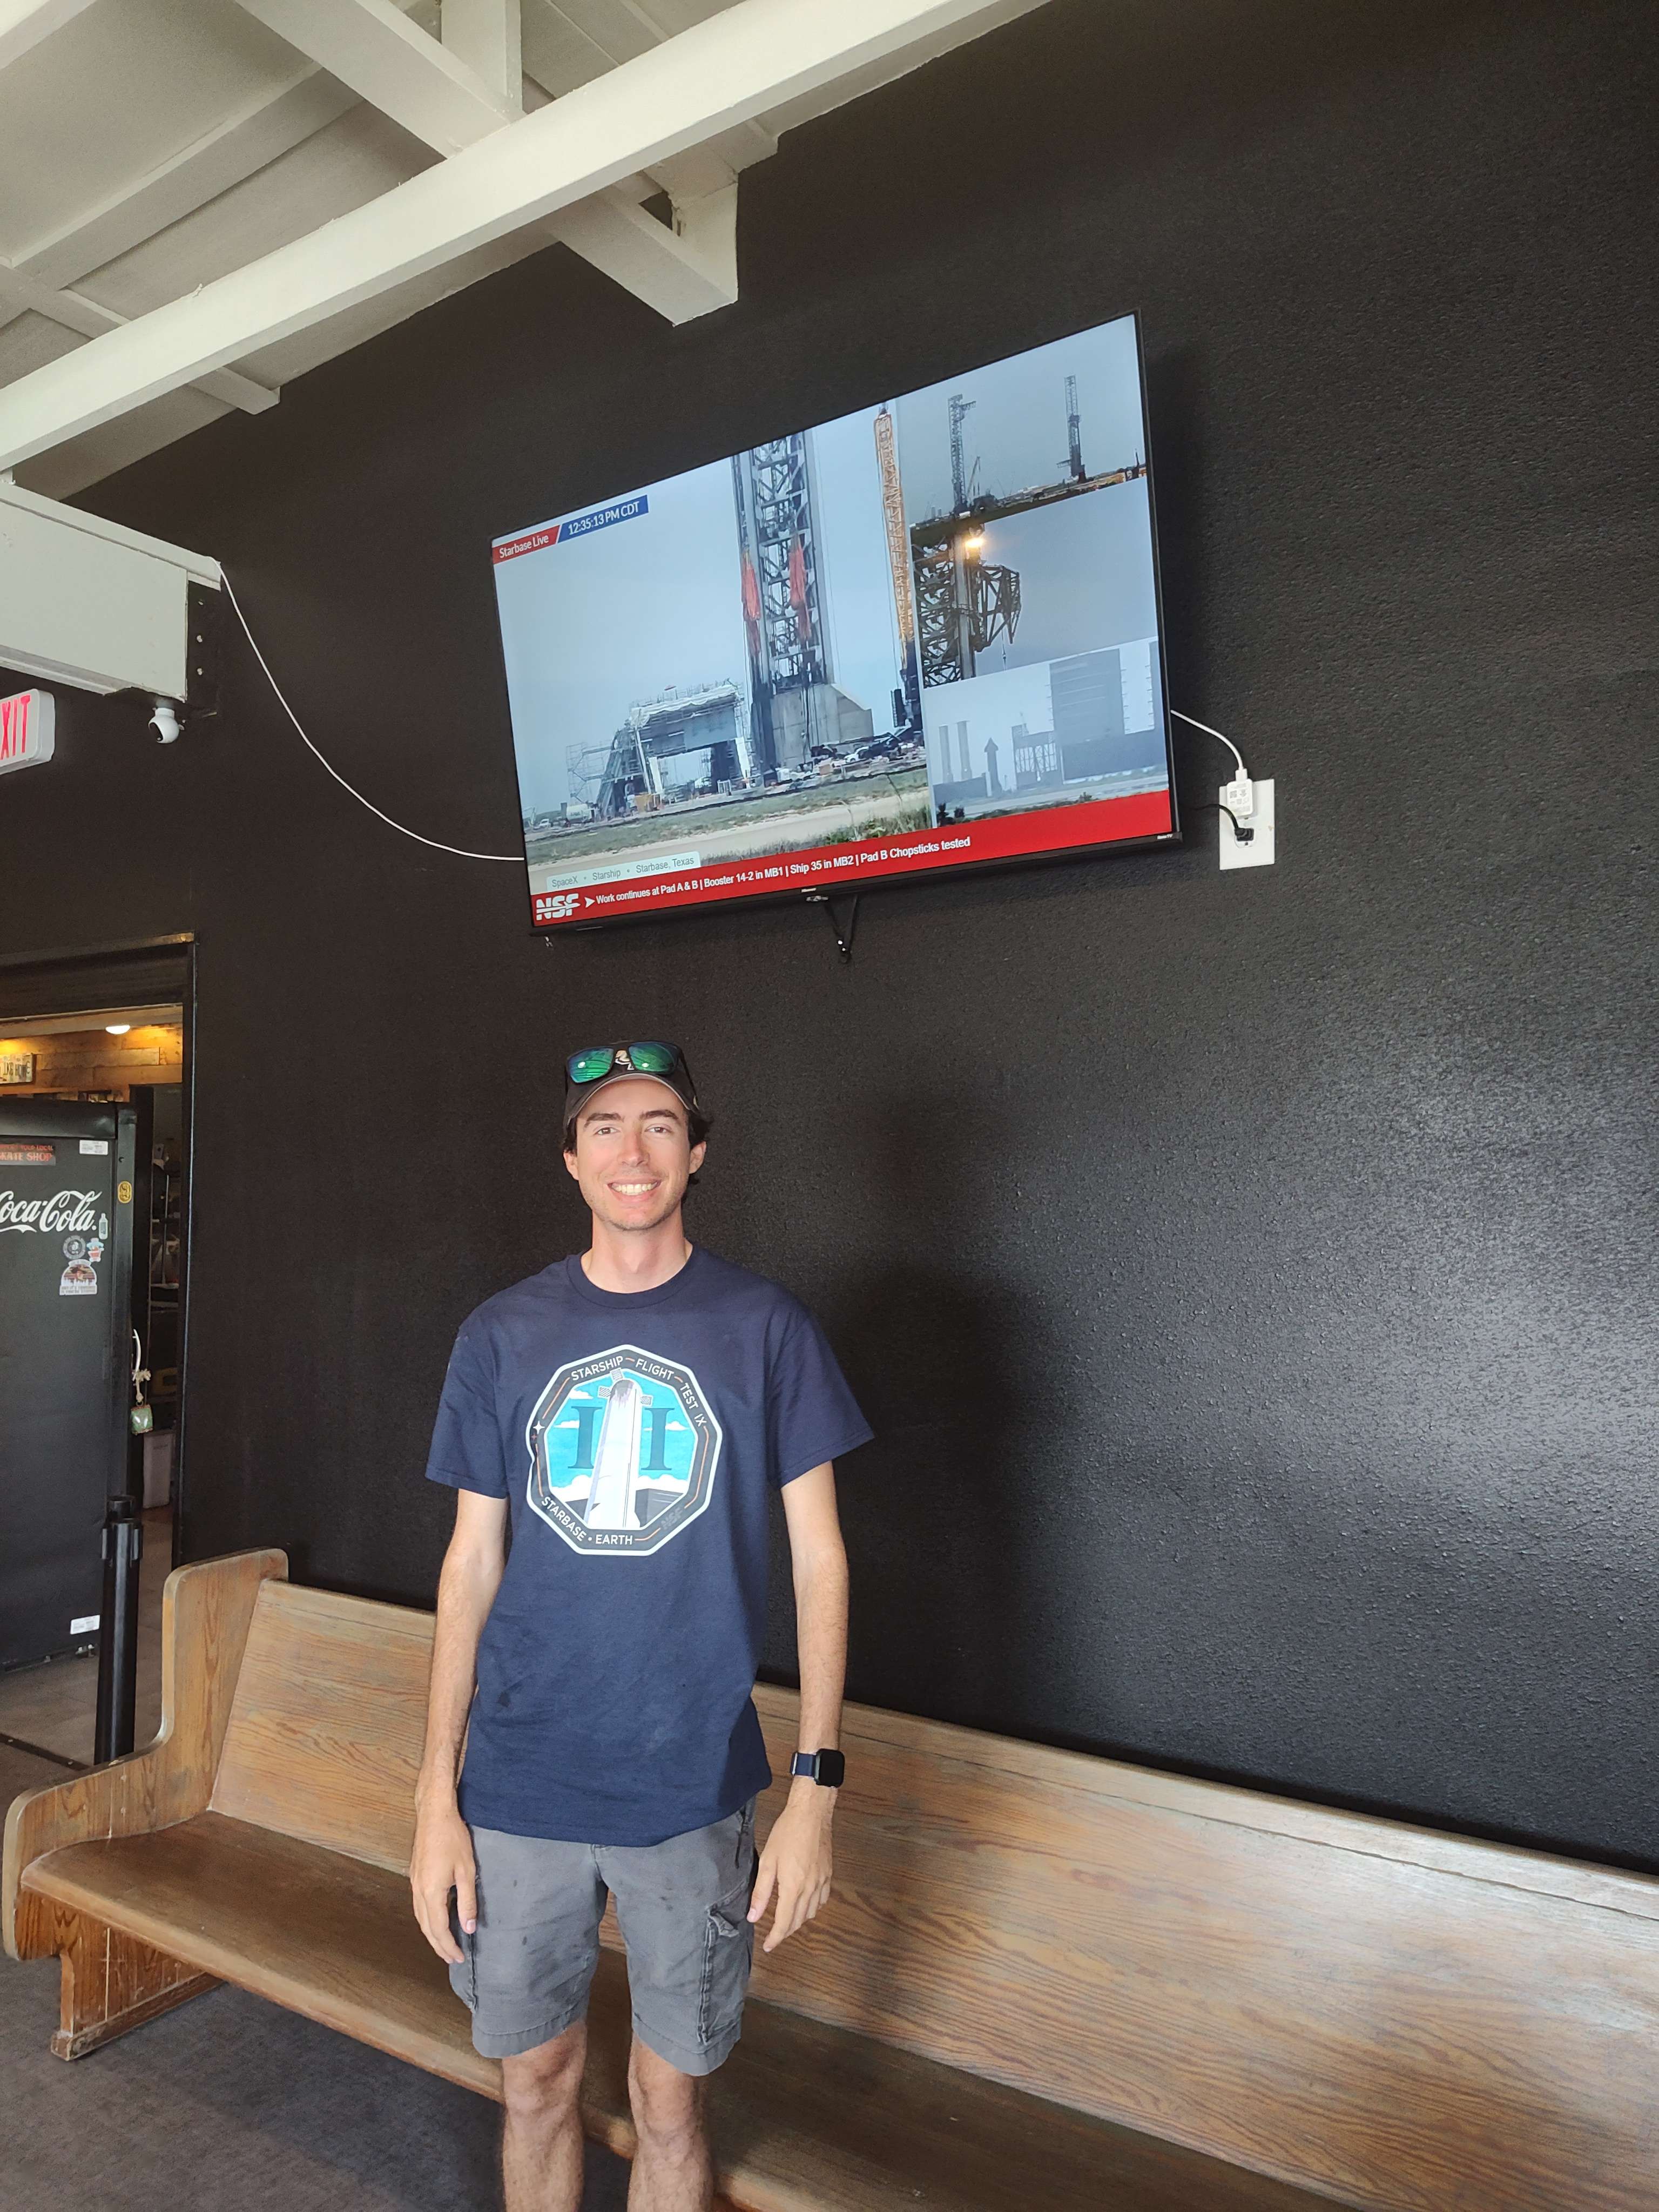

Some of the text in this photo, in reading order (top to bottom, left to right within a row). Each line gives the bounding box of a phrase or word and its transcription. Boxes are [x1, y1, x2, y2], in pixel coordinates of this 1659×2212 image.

[568, 501, 639, 535] 12:35:13 PM CDT
[500, 534, 549, 558] Starbase Live
[1, 693, 31, 760] XIT
[592, 868, 621, 881] Starship
[596, 894, 615, 904] Work
[616, 889, 651, 901] continues
[660, 884, 676, 894] Pad
[676, 882, 684, 892] A
[684, 882, 691, 891] &
[692, 880, 698, 889] B
[704, 875, 734, 887] Booster
[736, 871, 754, 882] 14-2
[756, 871, 763, 879] in
[765, 867, 783, 878] MB1
[790, 864, 810, 874] Ship
[811, 861, 822, 871] 35
[824, 860, 832, 868] in
[833, 855, 854, 867] MB2
[861, 852, 879, 863] Pad
[880, 851, 888, 860] B
[889, 842, 940, 858] Chopsticks
[941, 837, 971, 850] tested
[672, 857, 694, 868] Texas
[551, 875, 578, 889] SpaceX
[570, 1355, 707, 1427] STARSHIP FLIGHT TEST IX
[541, 1496, 633, 1545] STARBASE EARTH
